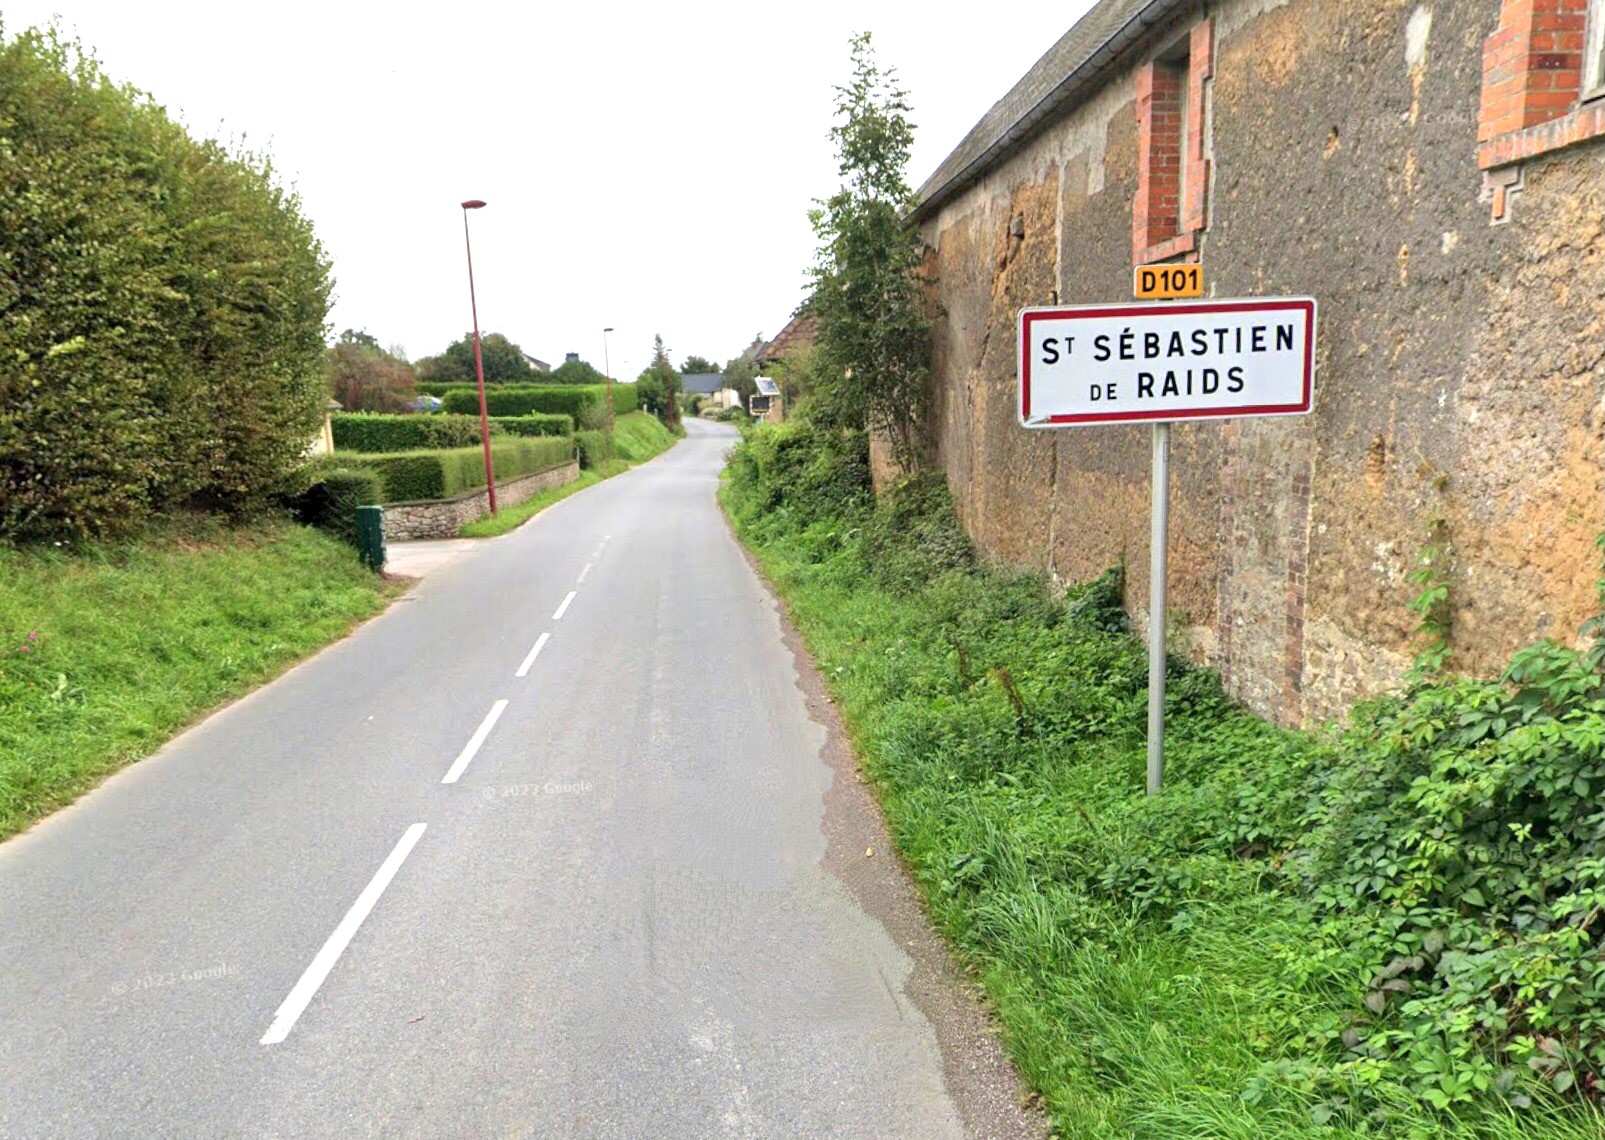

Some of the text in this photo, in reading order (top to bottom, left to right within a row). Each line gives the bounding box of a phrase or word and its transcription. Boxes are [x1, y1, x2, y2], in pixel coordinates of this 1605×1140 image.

[1142, 268, 1198, 293] D101
[1042, 324, 1294, 365] ST SÉBASTIEN
[1090, 366, 1245, 402] DE RAIDS
